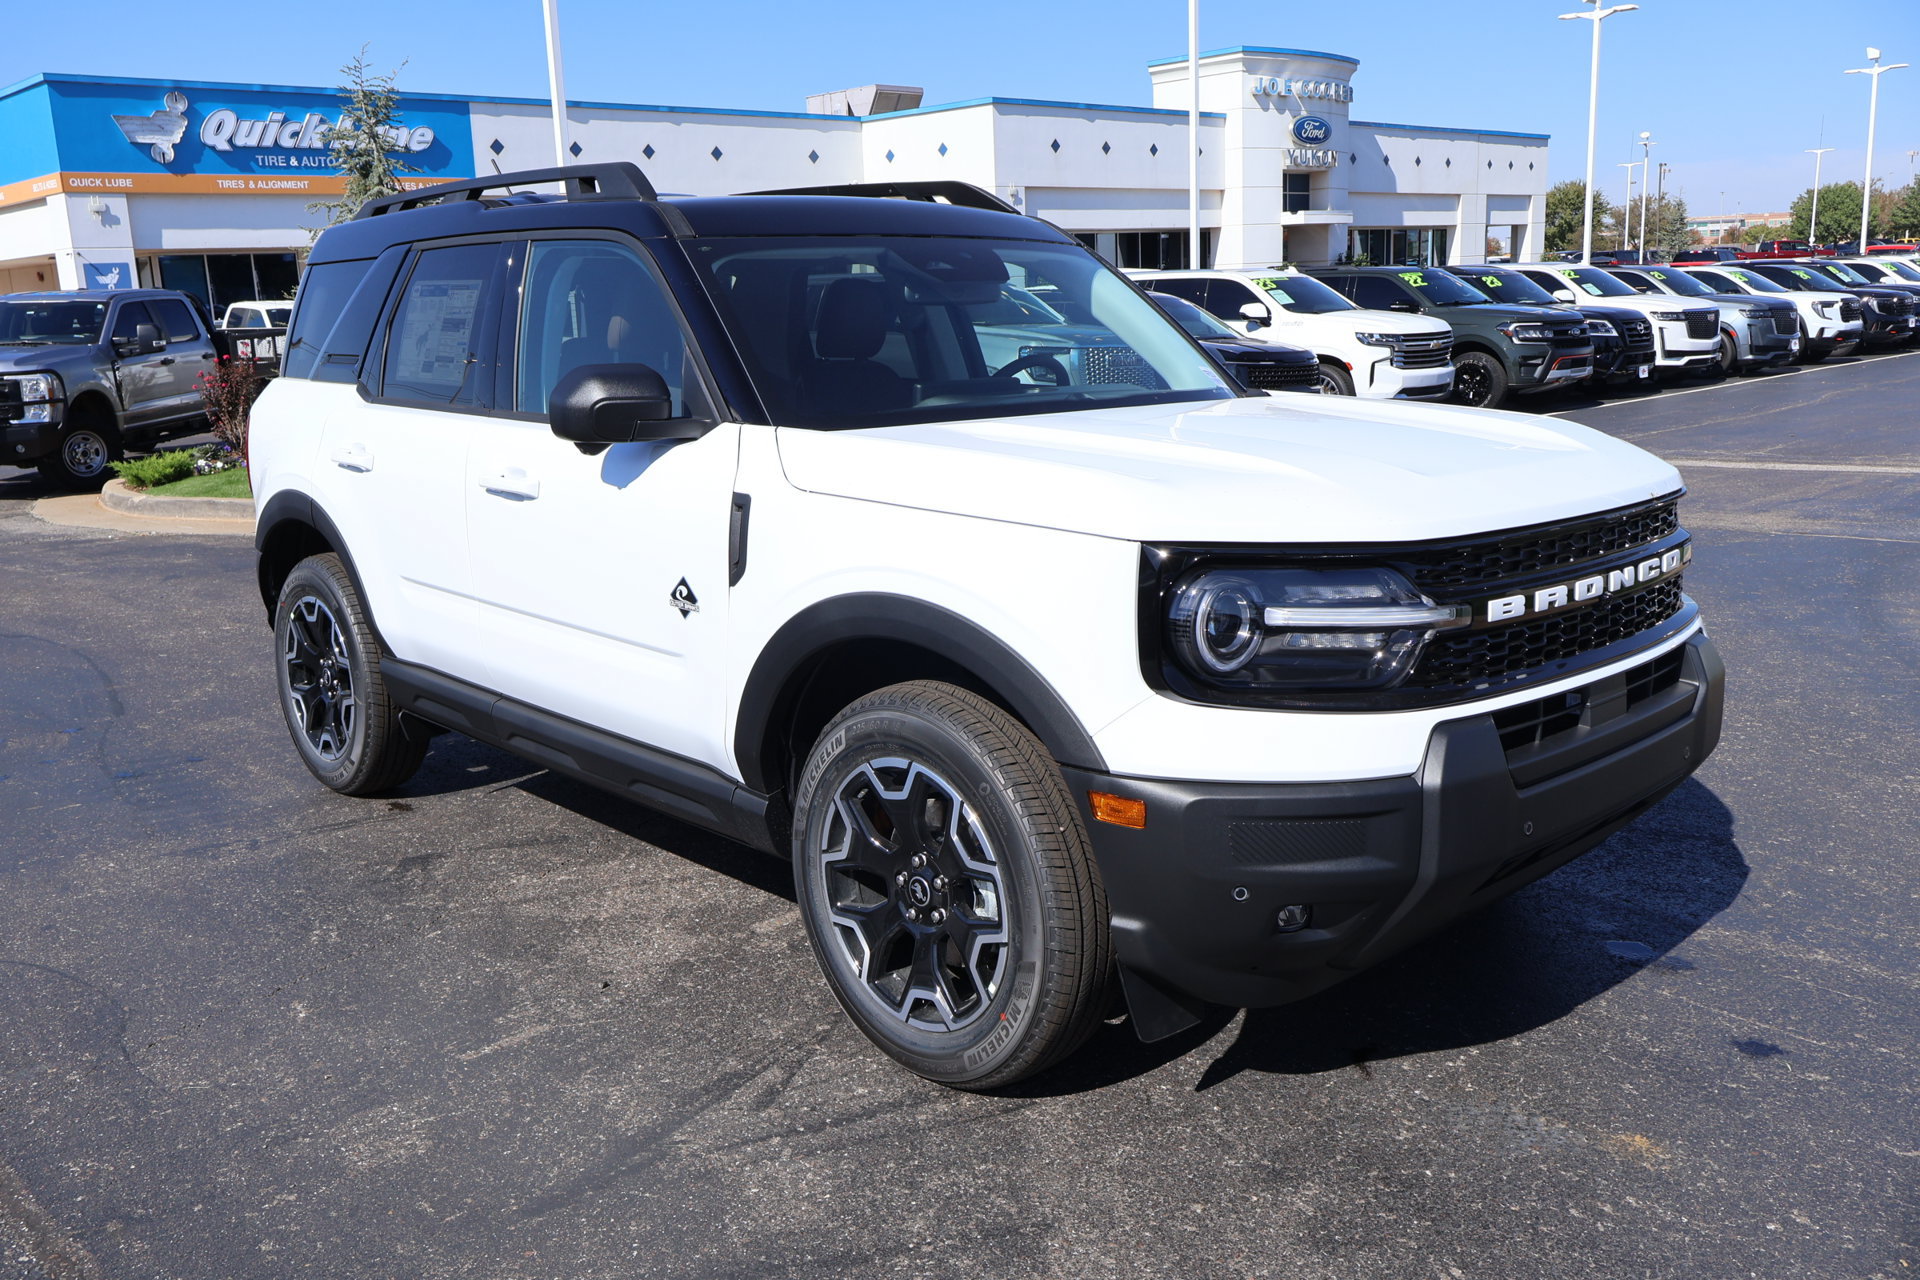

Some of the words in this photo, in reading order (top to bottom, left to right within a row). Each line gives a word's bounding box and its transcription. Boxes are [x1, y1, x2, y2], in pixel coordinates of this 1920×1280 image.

[1254, 78, 1293, 95] JOE
[1299, 80, 1353, 102] COOPER
[200, 108, 328, 151] Quick
[1301, 120, 1325, 138] Ford
[256, 155, 287, 166] TIRE
[290, 155, 299, 166] &
[301, 157, 337, 167] AUTO
[1287, 149, 1337, 167] YUKON
[69, 178, 103, 187] QUICK
[106, 179, 133, 187] LUBE
[217, 180, 245, 189] TIRES
[249, 180, 255, 188] &
[256, 180, 310, 189] ALIGNMENT
[1482, 275, 1503, 288] 23
[1487, 549, 1681, 622] BRONCO
[802, 733, 844, 804] MICHELIN
[967, 1002, 1022, 1068] MICHELIN
